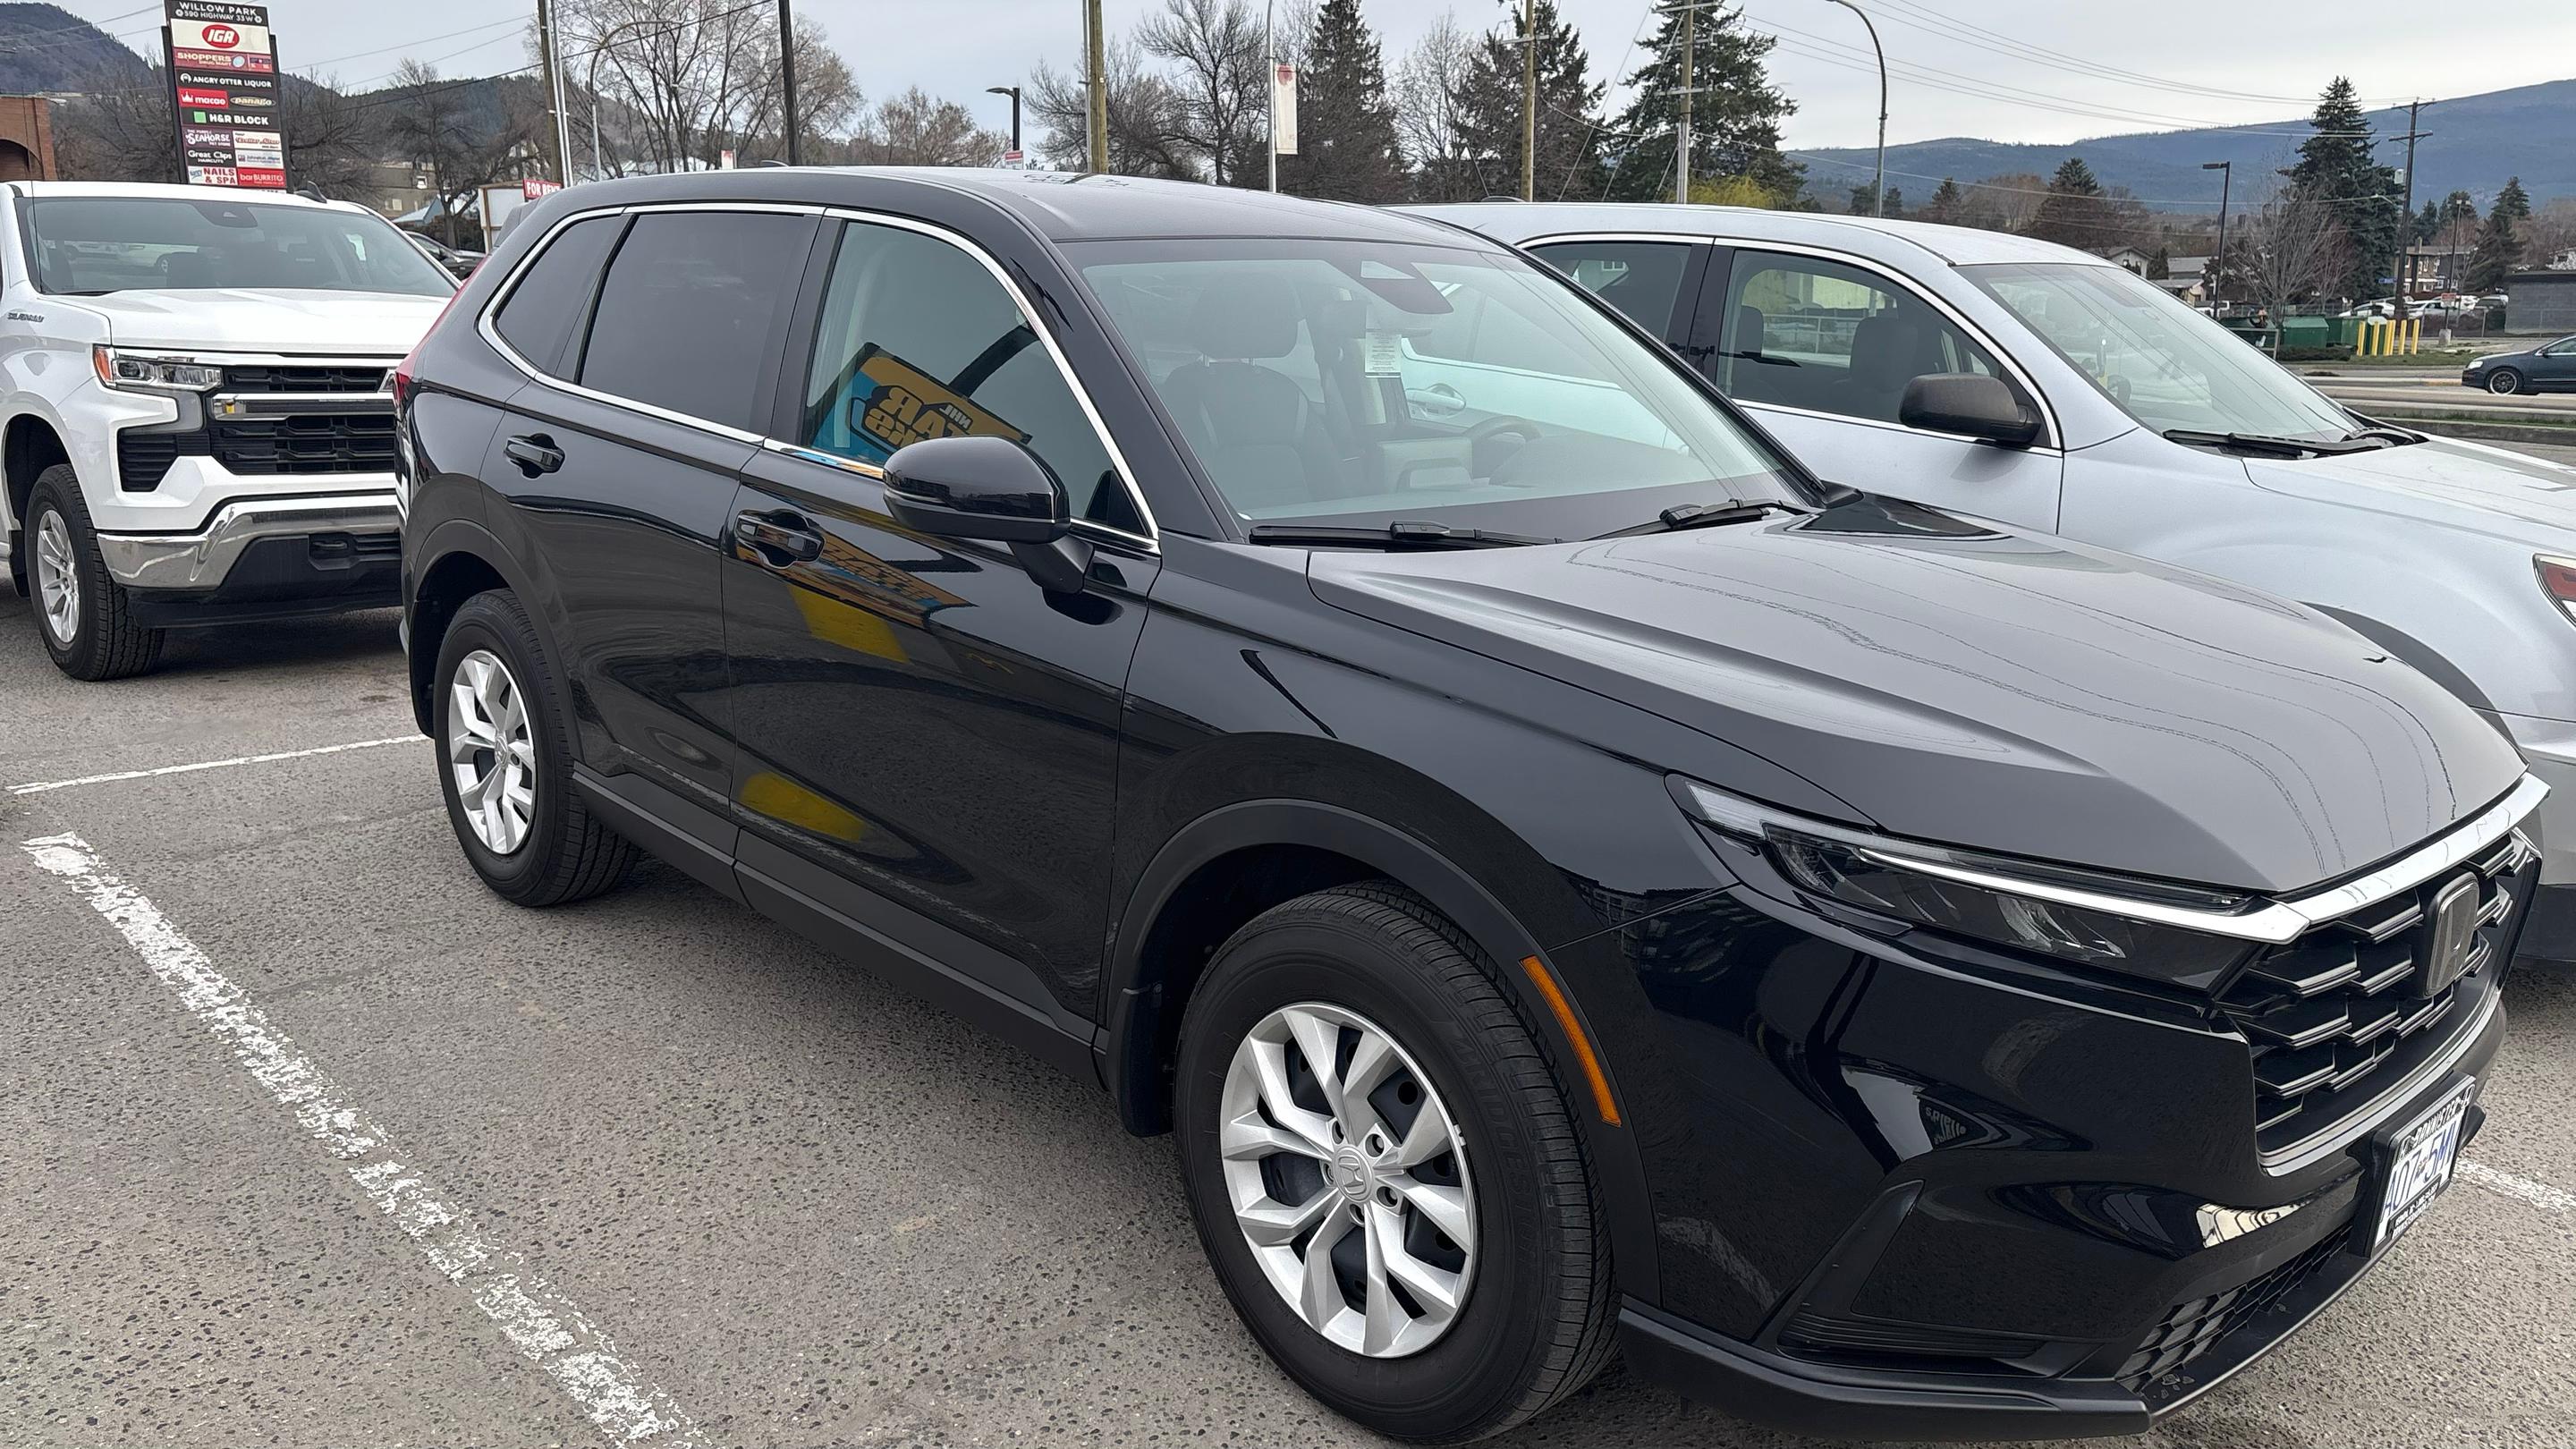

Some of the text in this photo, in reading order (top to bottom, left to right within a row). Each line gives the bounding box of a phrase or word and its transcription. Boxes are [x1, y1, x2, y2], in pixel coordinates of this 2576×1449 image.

[179, 2, 257, 16] WILLOW PARK
[184, 10, 199, 18] 590
[200, 11, 234, 21] HIGHWAY
[208, 29, 234, 44] IGA
[177, 52, 232, 62] SHOPPERS
[192, 76, 272, 88] ANGRY OTTER LIQUOR
[195, 97, 226, 106] macao
[234, 97, 272, 106] panago
[209, 114, 269, 125] H&R BLOCK
[188, 149, 233, 160] Great Clips
[203, 167, 234, 176] NAILS
[216, 176, 236, 184] SPA
[526, 182, 542, 196] FOR
